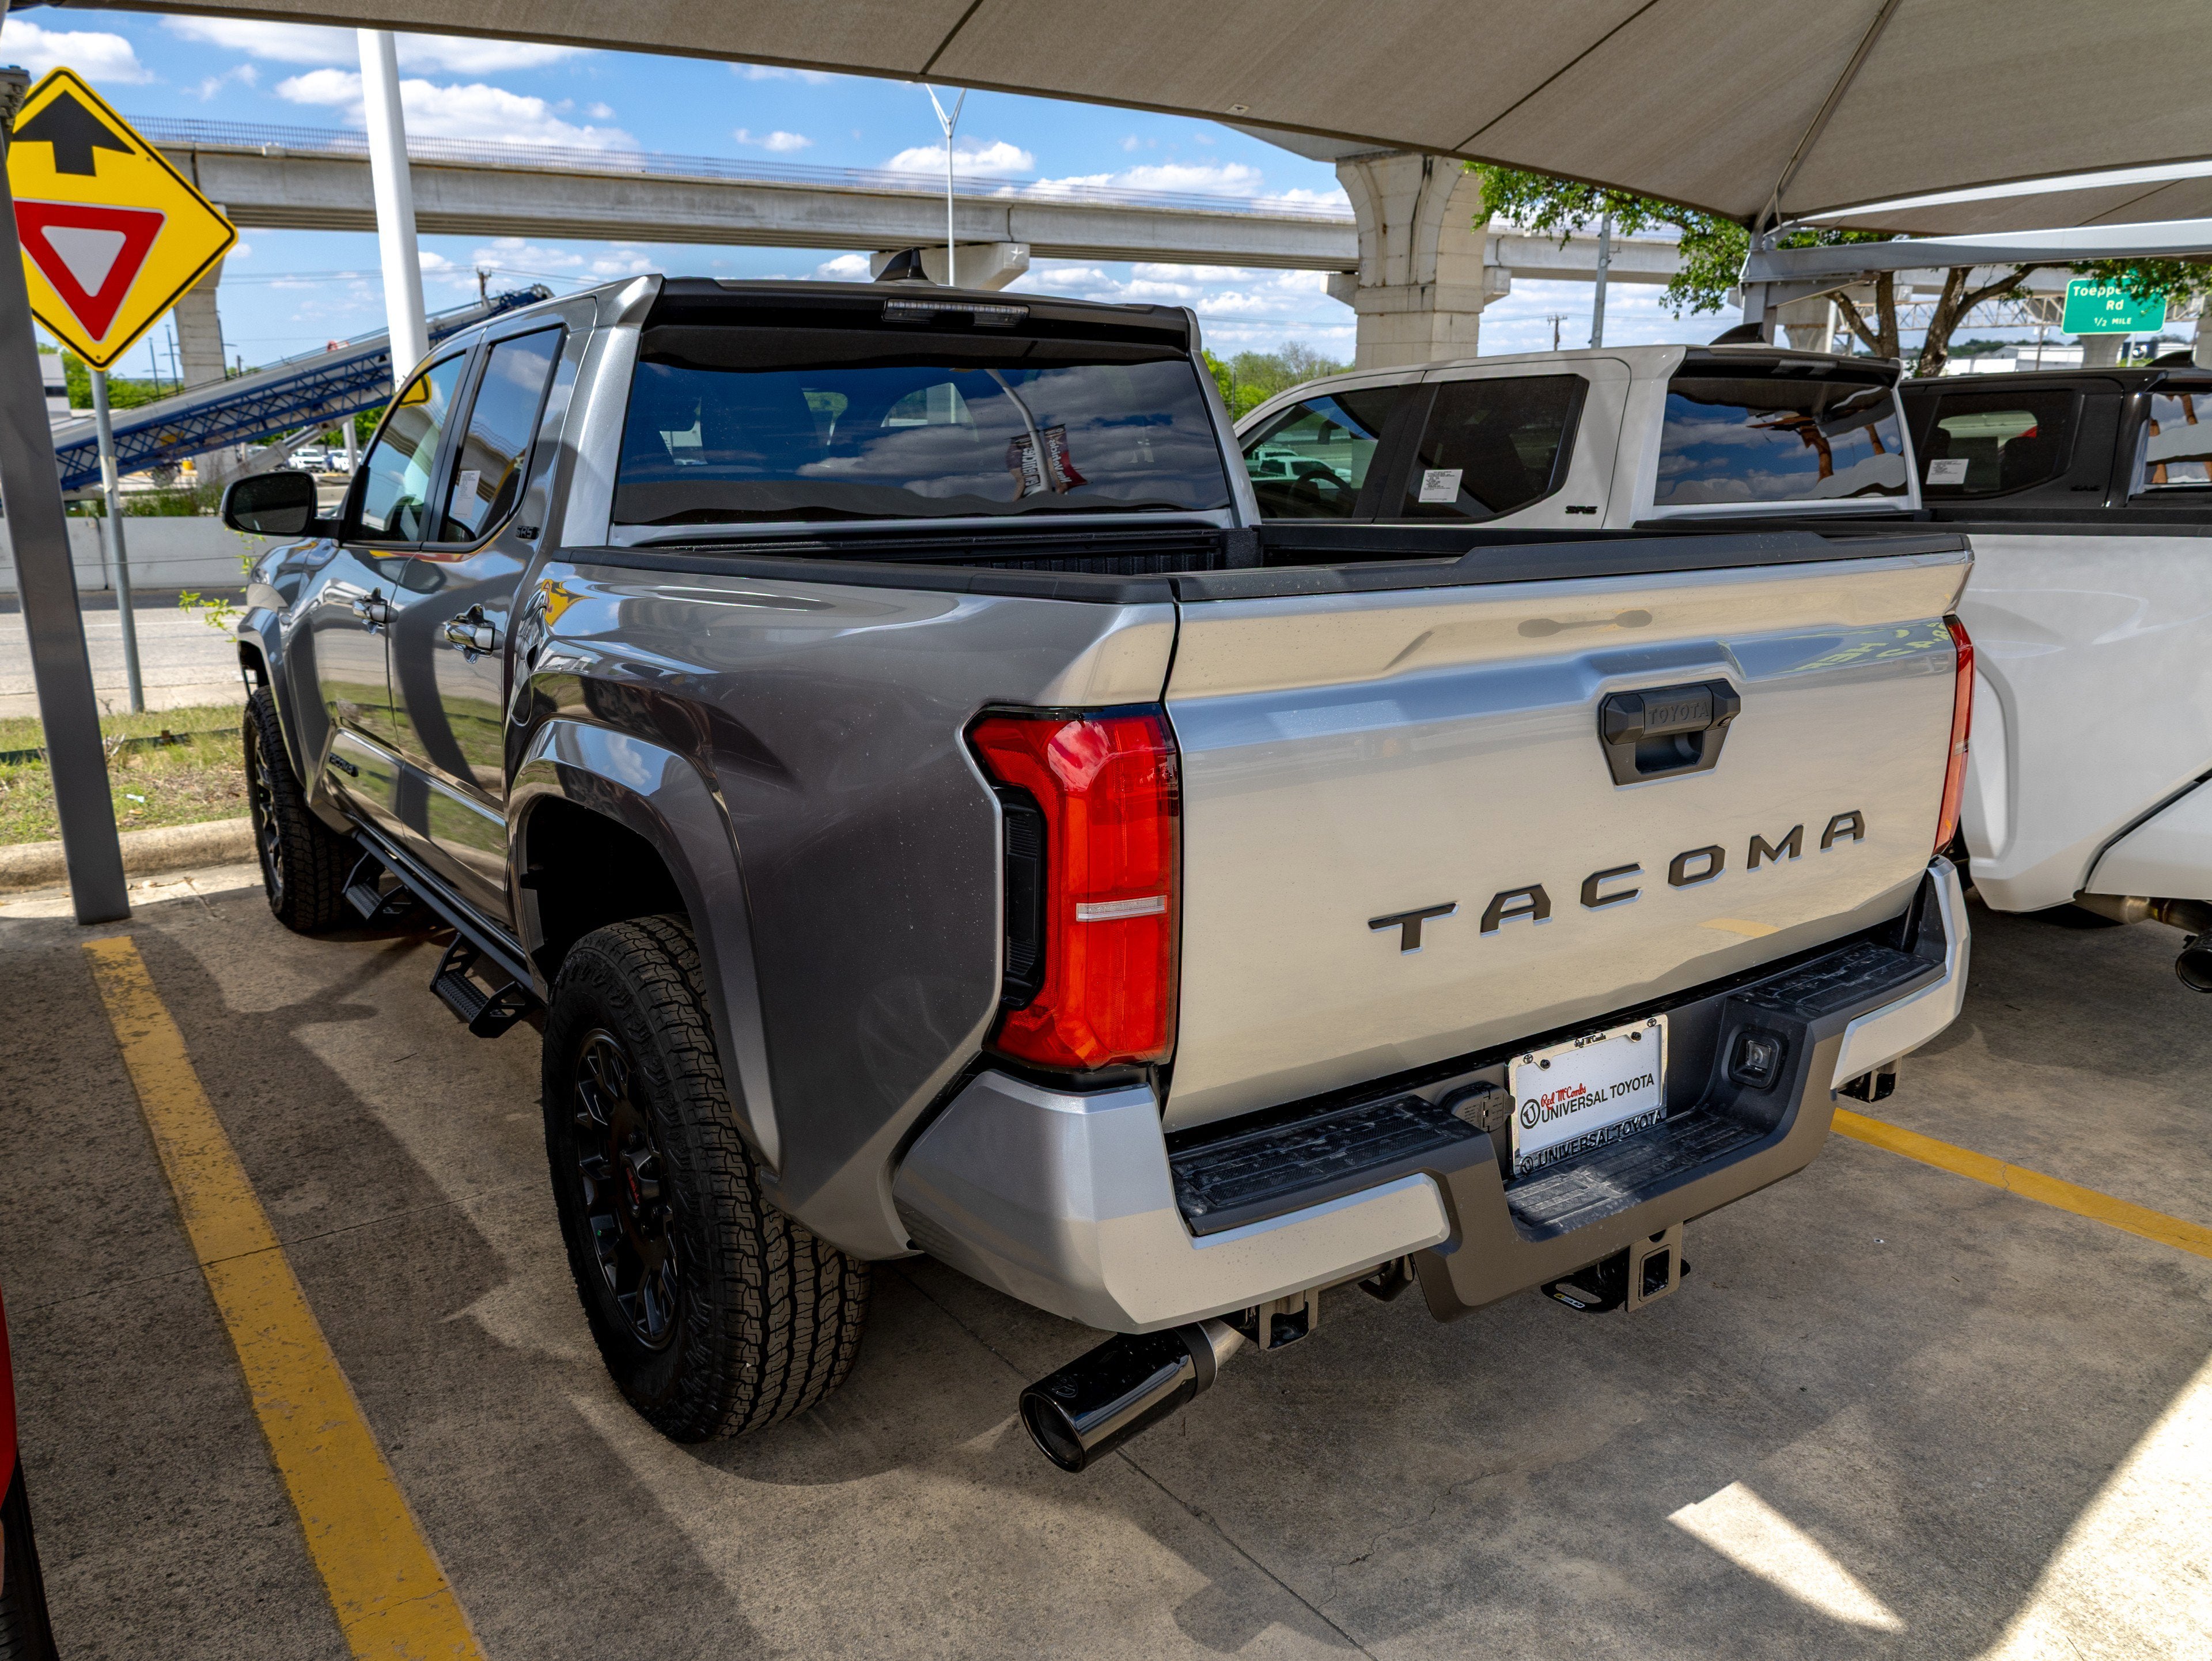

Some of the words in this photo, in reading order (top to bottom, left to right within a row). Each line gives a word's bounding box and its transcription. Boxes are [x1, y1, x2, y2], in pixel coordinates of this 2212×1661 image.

[2106, 299, 2124, 311] Rd
[1648, 702, 1709, 724] TOYOTA
[1368, 809, 1866, 954] TACOMA
[1541, 1094, 1555, 1110] Red
[1555, 1083, 1586, 1102] McCombs
[1541, 1088, 1608, 1123] UNIVERSAL
[1609, 1073, 1654, 1098] TOYOTA
[1538, 1127, 1613, 1167] UNIVERSAL
[1611, 1110, 1663, 1138] TOYOTA
